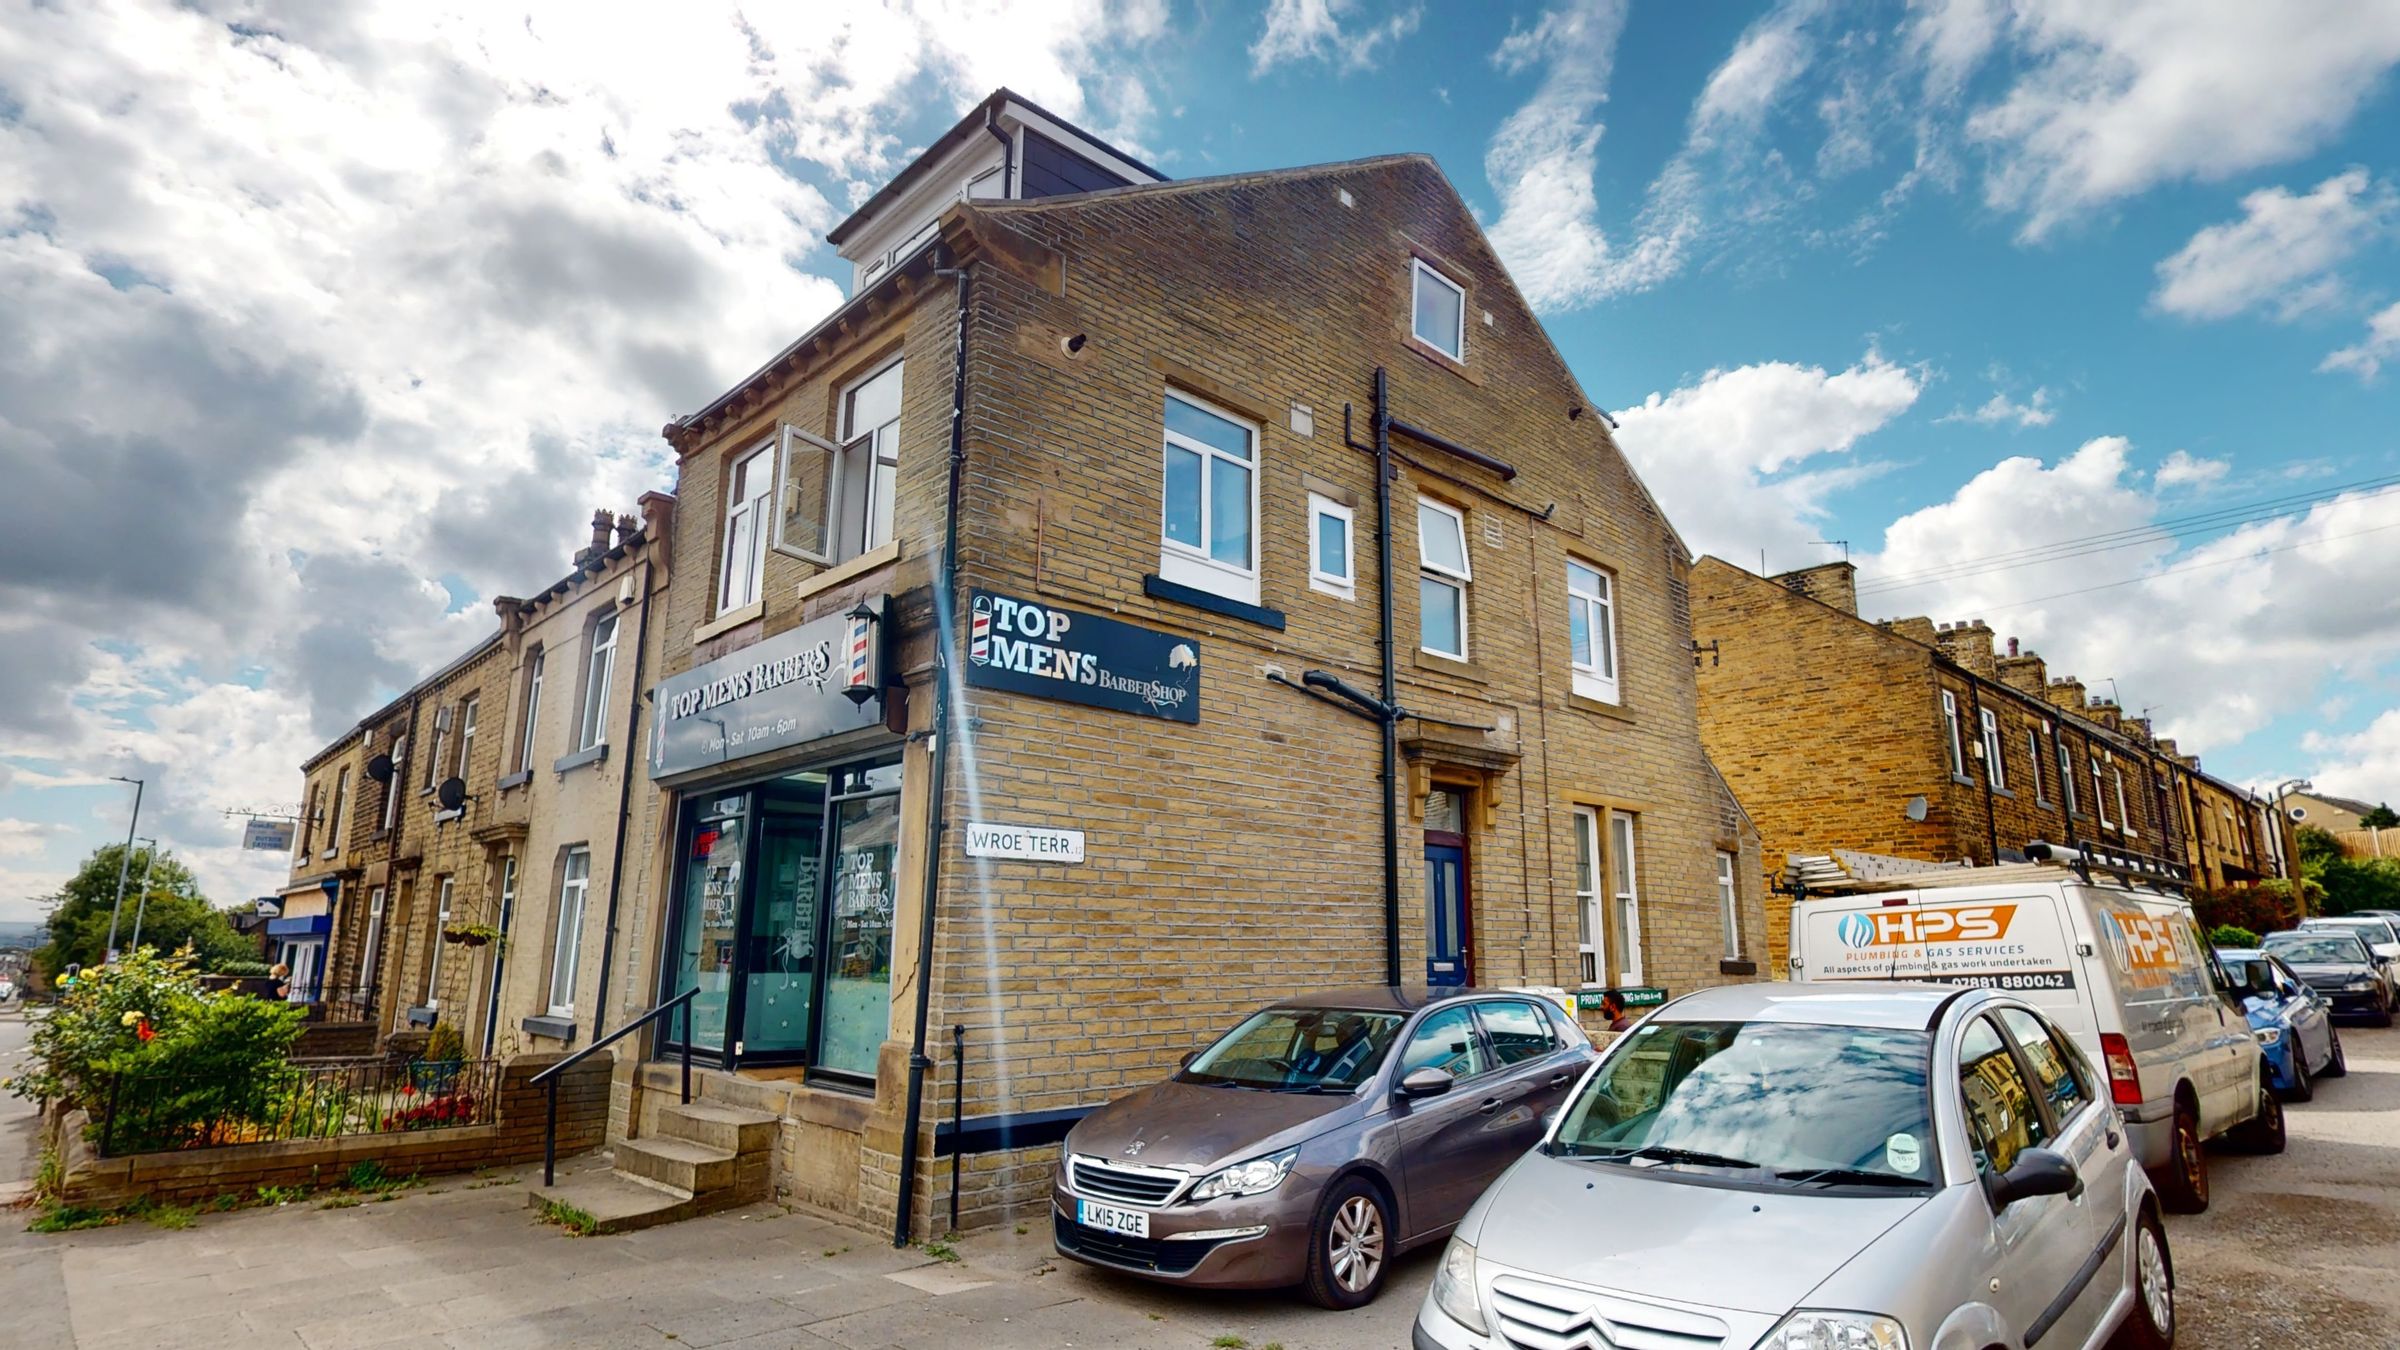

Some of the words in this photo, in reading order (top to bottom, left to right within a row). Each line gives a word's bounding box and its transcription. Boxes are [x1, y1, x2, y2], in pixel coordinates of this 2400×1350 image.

[994, 597, 1071, 642] TOP
[990, 634, 1097, 686] MENS
[671, 690, 702, 721] TOP
[702, 672, 750, 711] MENS
[708, 737, 725, 752] Mon
[730, 731, 744, 747] Sat
[748, 726, 769, 742] 10am
[776, 718, 797, 736] 6pm
[972, 831, 1023, 851] WROE
[1029, 835, 1074, 855] TERR.
[850, 852, 875, 871] TOP
[848, 871, 883, 890] MENS
[1876, 908, 1999, 943] HPS
[1846, 950, 1909, 961] PLUMBING
[1913, 949, 1922, 958] &
[1927, 948, 1953, 958] GAS
[1958, 945, 2025, 957] SERVICES
[2119, 918, 2178, 963] HPS
[1823, 965, 1835, 974] All
[1837, 963, 1871, 975] aspects
[1873, 963, 1883, 972] of
[1885, 961, 1930, 974] plumbing
[1931, 961, 1939, 970] &
[1941, 960, 1959, 972] gas
[1961, 958, 1987, 969] work
[1990, 957, 2053, 968] undertaken
[2001, 974, 2065, 989] 880042
[1580, 993, 1604, 1005] PRIVAT
[1087, 1204, 1114, 1227] LK15
[1117, 1211, 1143, 1234] ZGE
